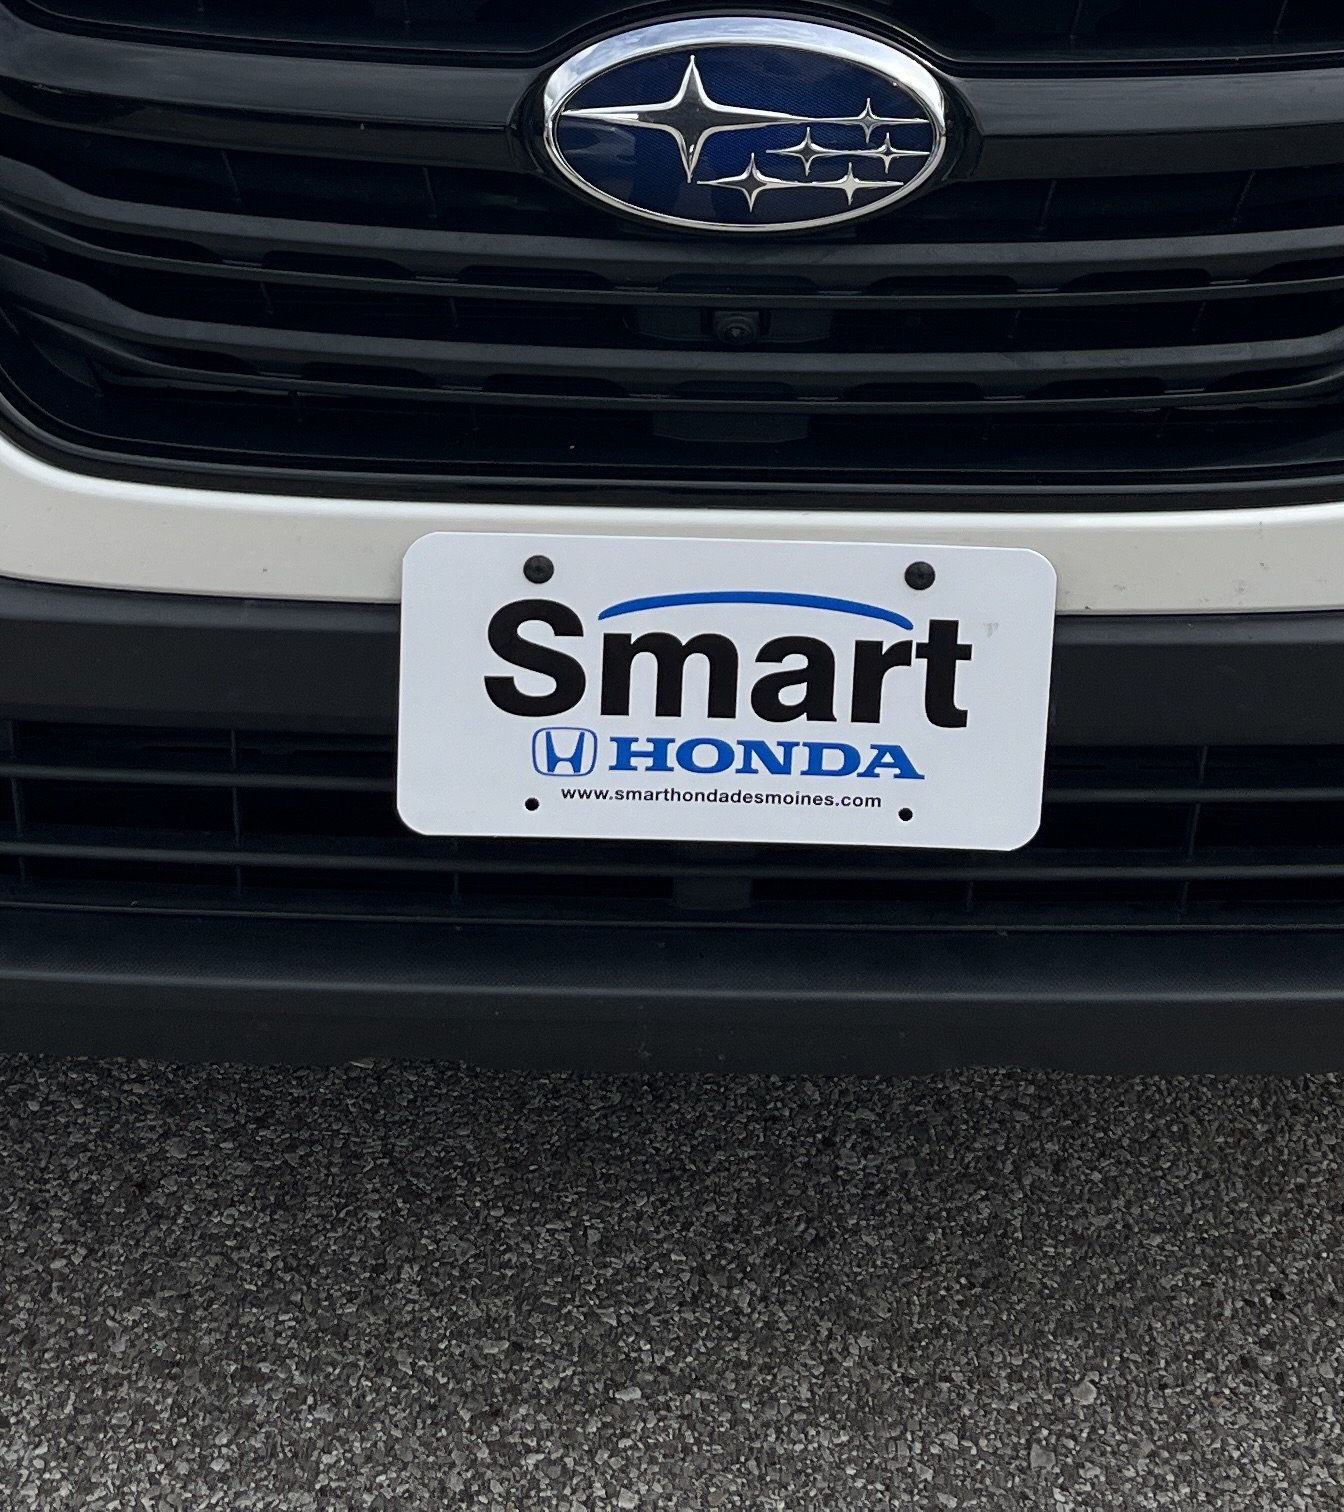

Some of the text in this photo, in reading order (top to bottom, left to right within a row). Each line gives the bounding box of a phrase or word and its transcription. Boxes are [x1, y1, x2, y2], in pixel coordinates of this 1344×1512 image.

[484, 599, 973, 729] Smart
[609, 737, 925, 780] HONDA
[561, 787, 882, 808] www.smarthondadesmoines.com
